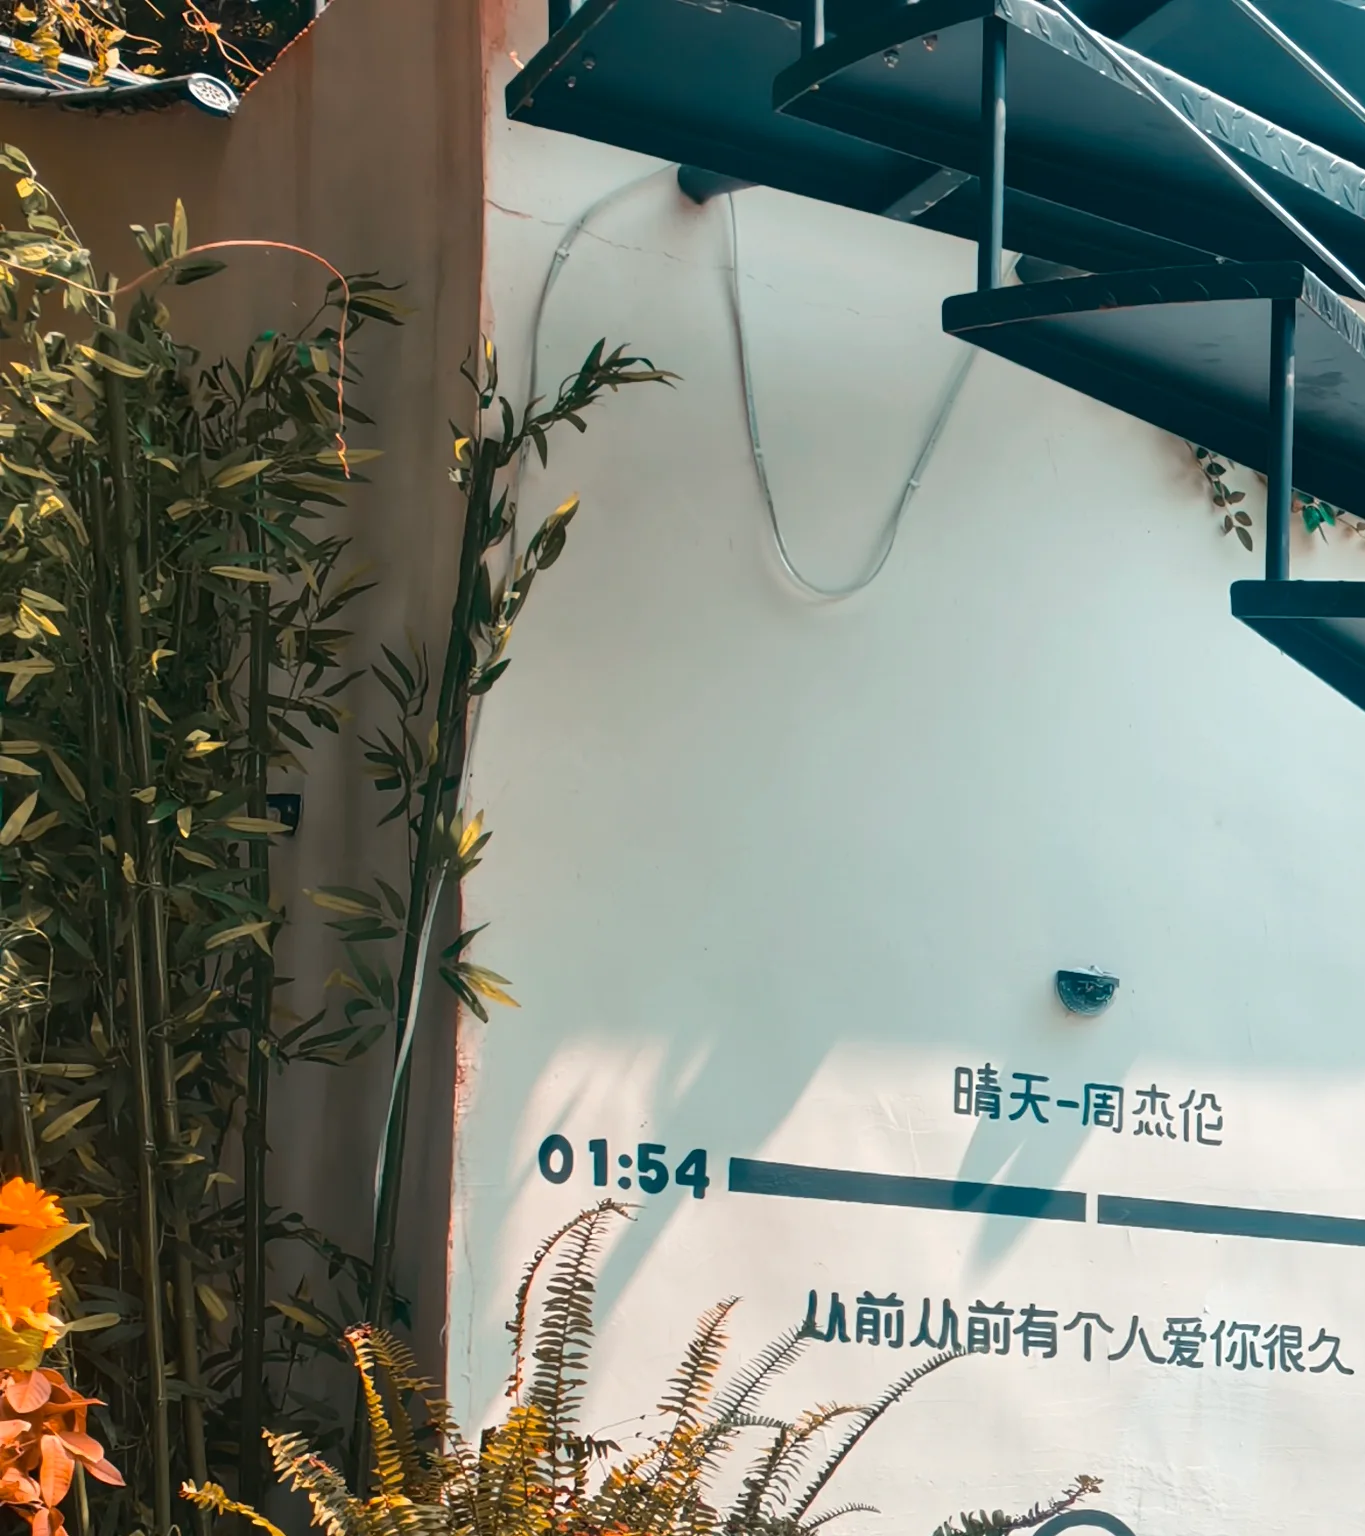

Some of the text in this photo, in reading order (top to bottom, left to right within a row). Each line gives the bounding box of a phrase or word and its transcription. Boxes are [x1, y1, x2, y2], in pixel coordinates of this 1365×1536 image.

[953, 1062, 1225, 1148] 晴天-周杰伦
[537, 1132, 711, 1200] 01:54
[806, 1288, 1355, 1376] 从前从前有个人爱你很久
